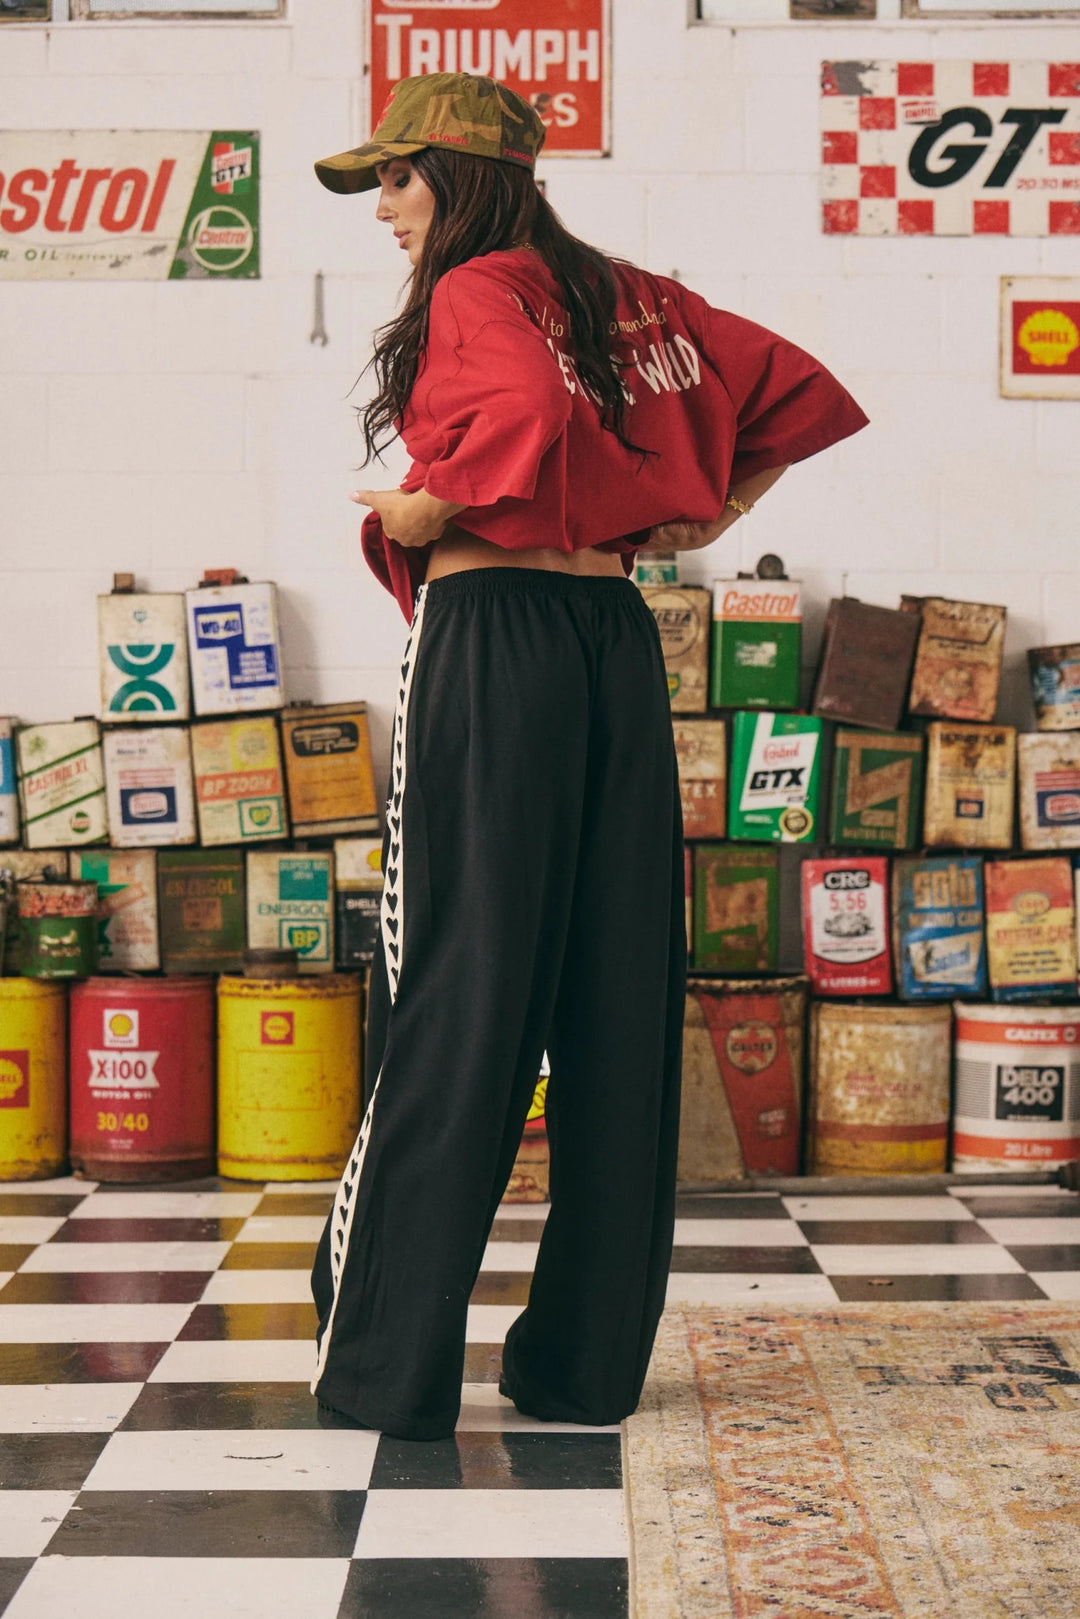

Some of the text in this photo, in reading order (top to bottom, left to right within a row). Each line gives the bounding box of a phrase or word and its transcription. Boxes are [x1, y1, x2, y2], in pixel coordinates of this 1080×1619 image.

[375, 14, 599, 81] TRIUMPH
[908, 106, 1068, 188] GT
[215, 163, 247, 183] GTX
[0, 159, 176, 233] strol
[24, 248, 58, 261] OIL
[550, 318, 564, 337] to
[1028, 330, 1069, 344] SHELL
[722, 590, 799, 616] Castrol
[203, 774, 273, 796] BP ZOOM
[750, 768, 805, 790] GTX
[825, 871, 869, 889] CRC
[258, 902, 327, 916] ENERGOL
[292, 930, 319, 948] BP
[1005, 1029, 1058, 1041] CALTEX
[1001, 1067, 1060, 1087] DELO
[1004, 1088, 1054, 1105] 400
[97, 1111, 149, 1132] 30/40
